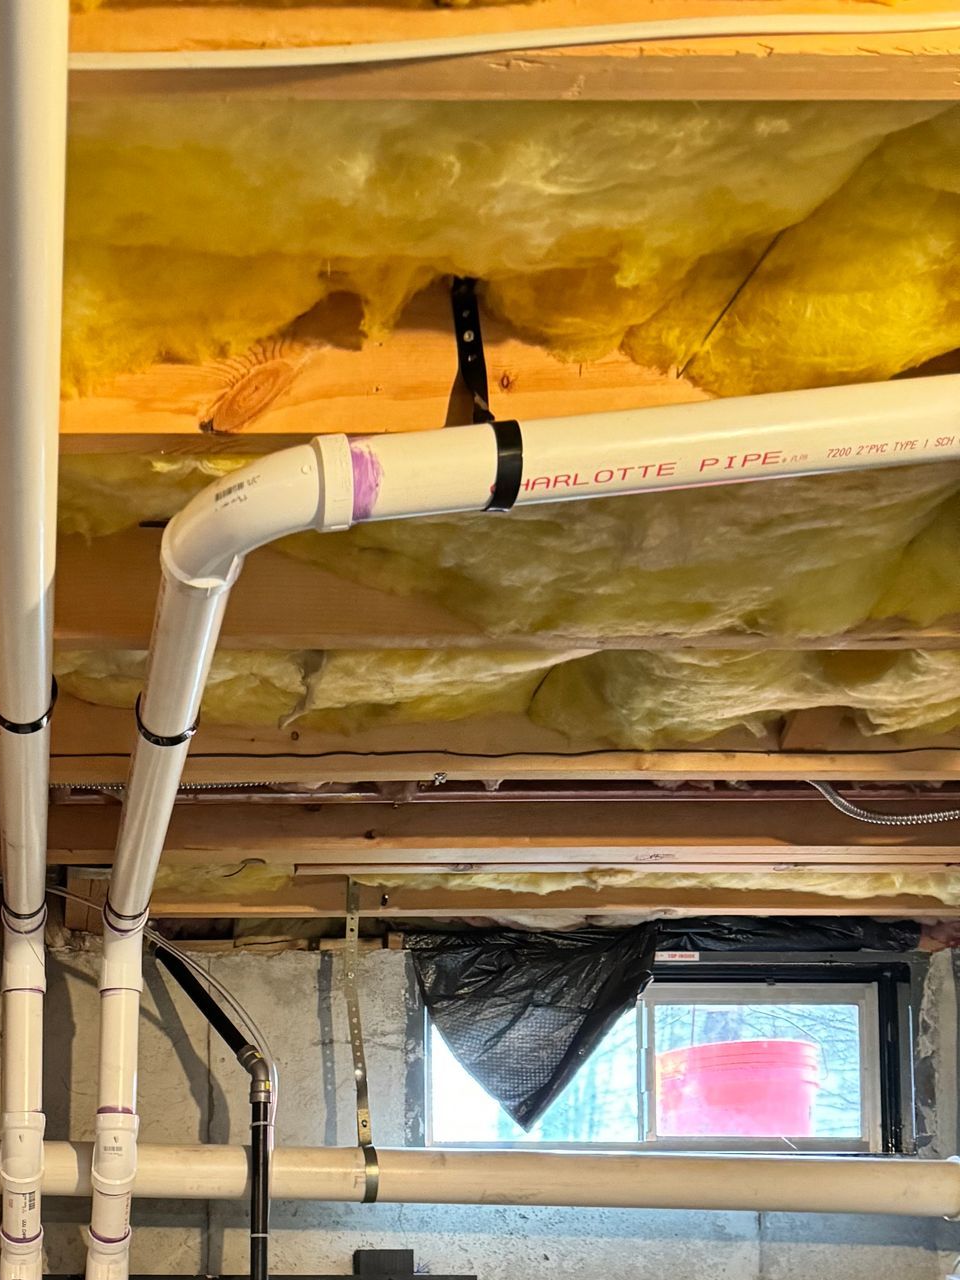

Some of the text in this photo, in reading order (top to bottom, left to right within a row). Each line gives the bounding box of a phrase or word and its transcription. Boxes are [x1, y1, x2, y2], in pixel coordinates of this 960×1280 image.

[827, 447, 852, 458] 7200
[894, 440, 919, 451] TYPE
[935, 436, 955, 447] SCH
[490, 451, 782, 495] HARLOTTE PIPE
